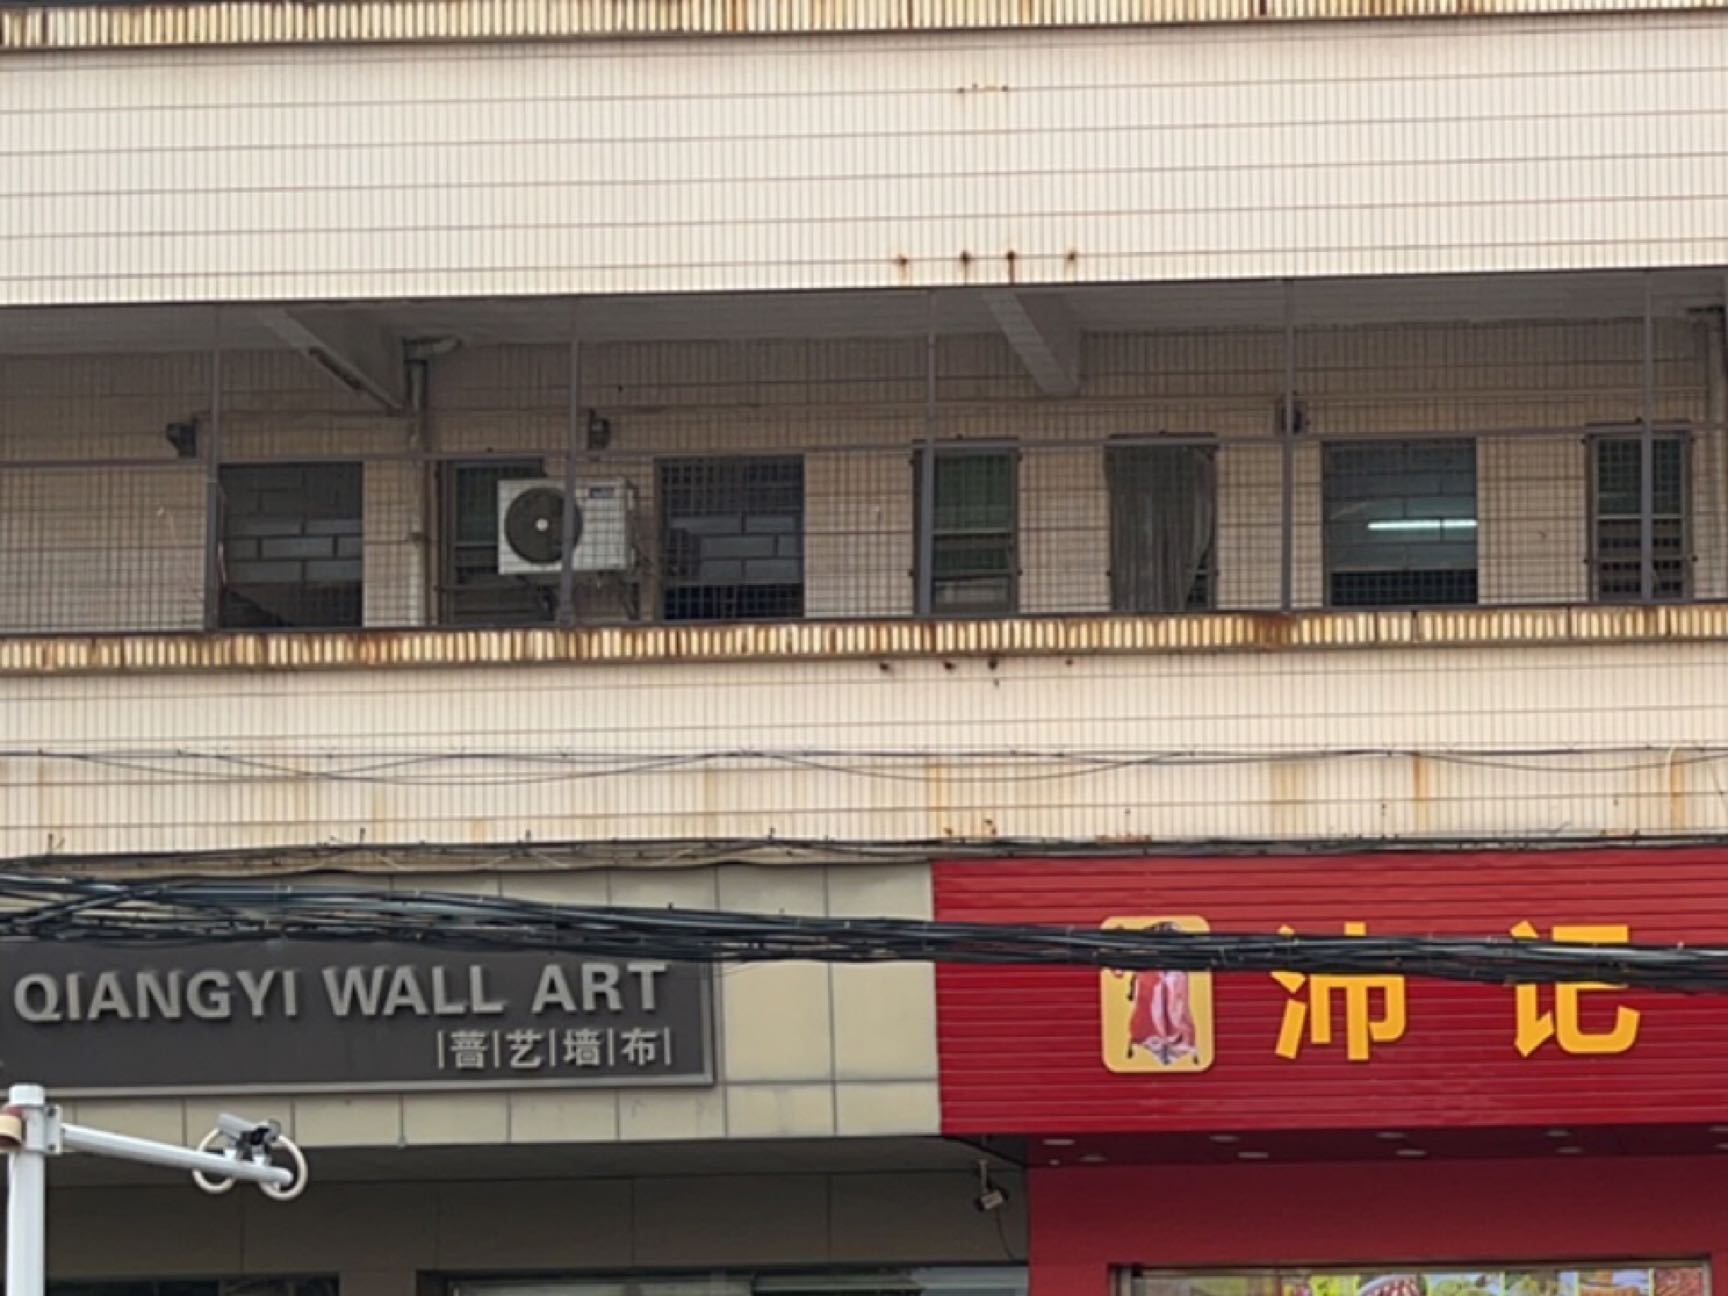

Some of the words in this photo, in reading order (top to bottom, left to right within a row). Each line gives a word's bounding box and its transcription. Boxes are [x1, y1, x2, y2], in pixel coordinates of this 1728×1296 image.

[14, 970, 298, 1023] QIANGYI
[322, 965, 505, 1016] WALL
[532, 963, 669, 1013] ART
